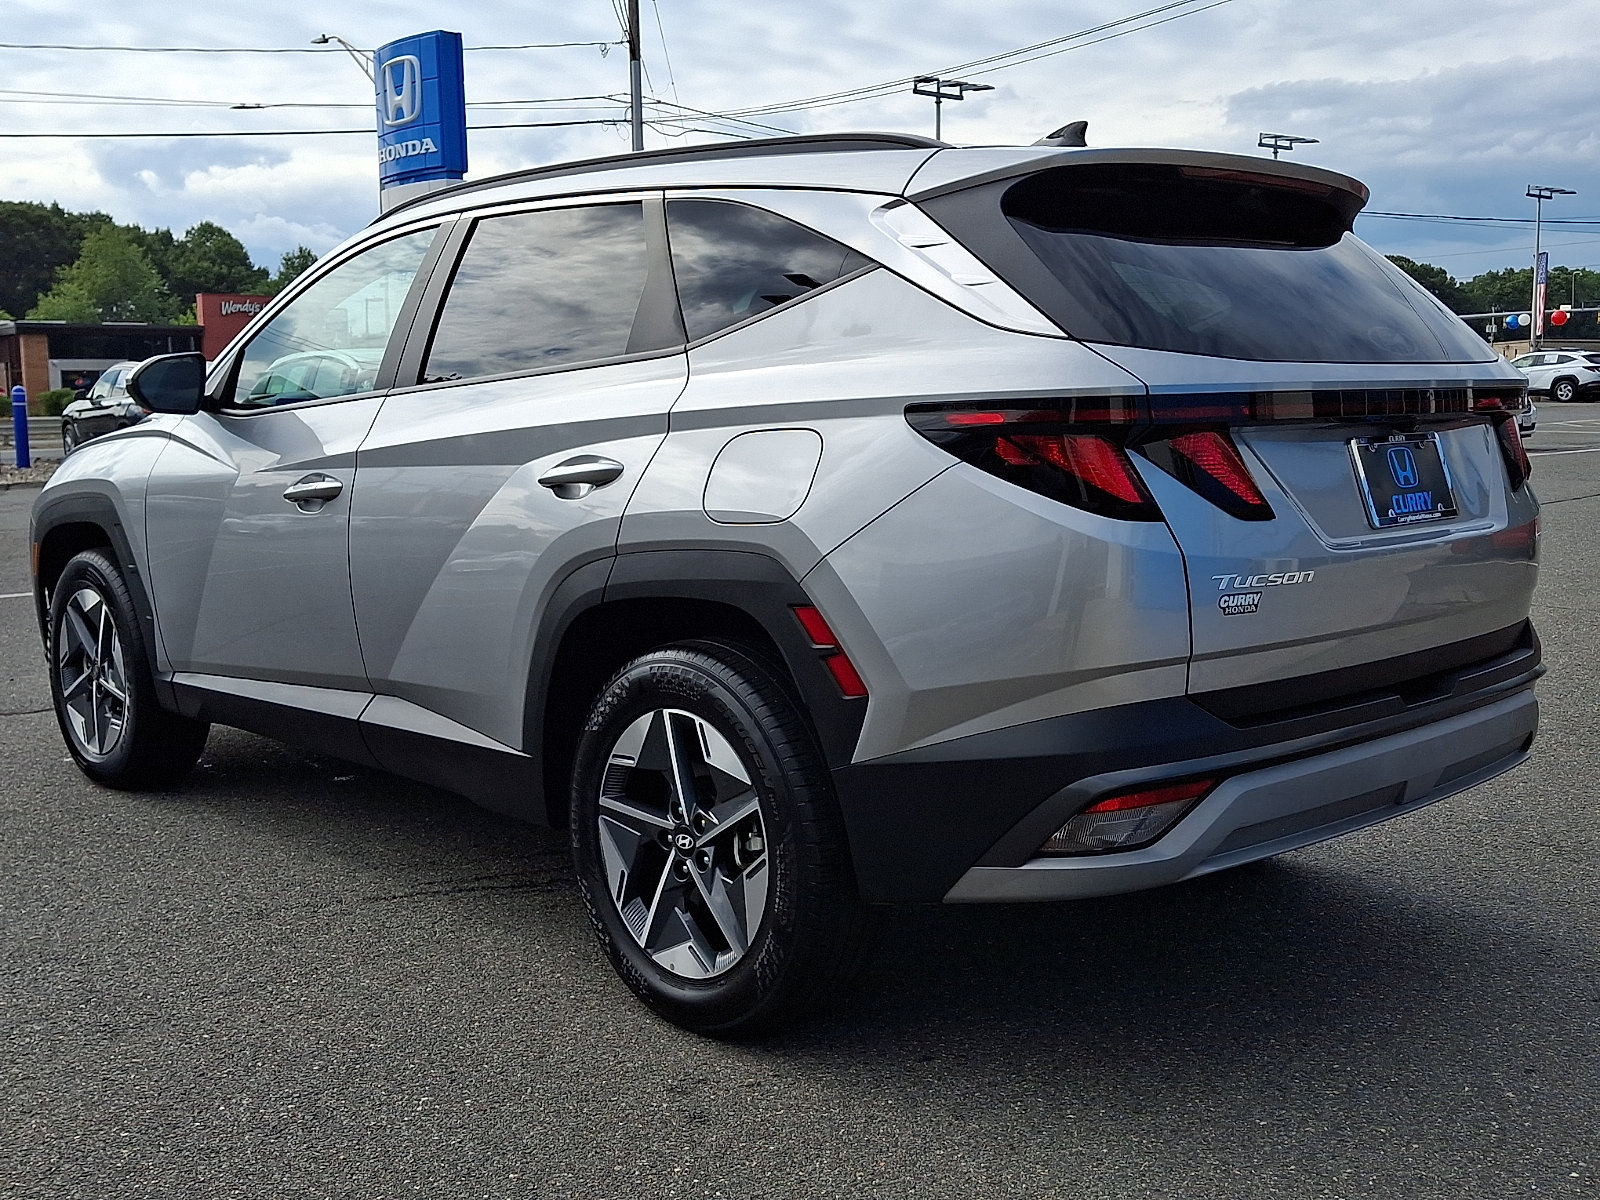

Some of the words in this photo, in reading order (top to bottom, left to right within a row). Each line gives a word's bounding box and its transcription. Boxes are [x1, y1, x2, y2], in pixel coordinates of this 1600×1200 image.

[378, 137, 438, 164] HONDA
[221, 300, 260, 316] Wendy's
[1392, 491, 1432, 514] CURRY
[1220, 593, 1261, 608] CURRY
[1224, 604, 1257, 615] HONDA
